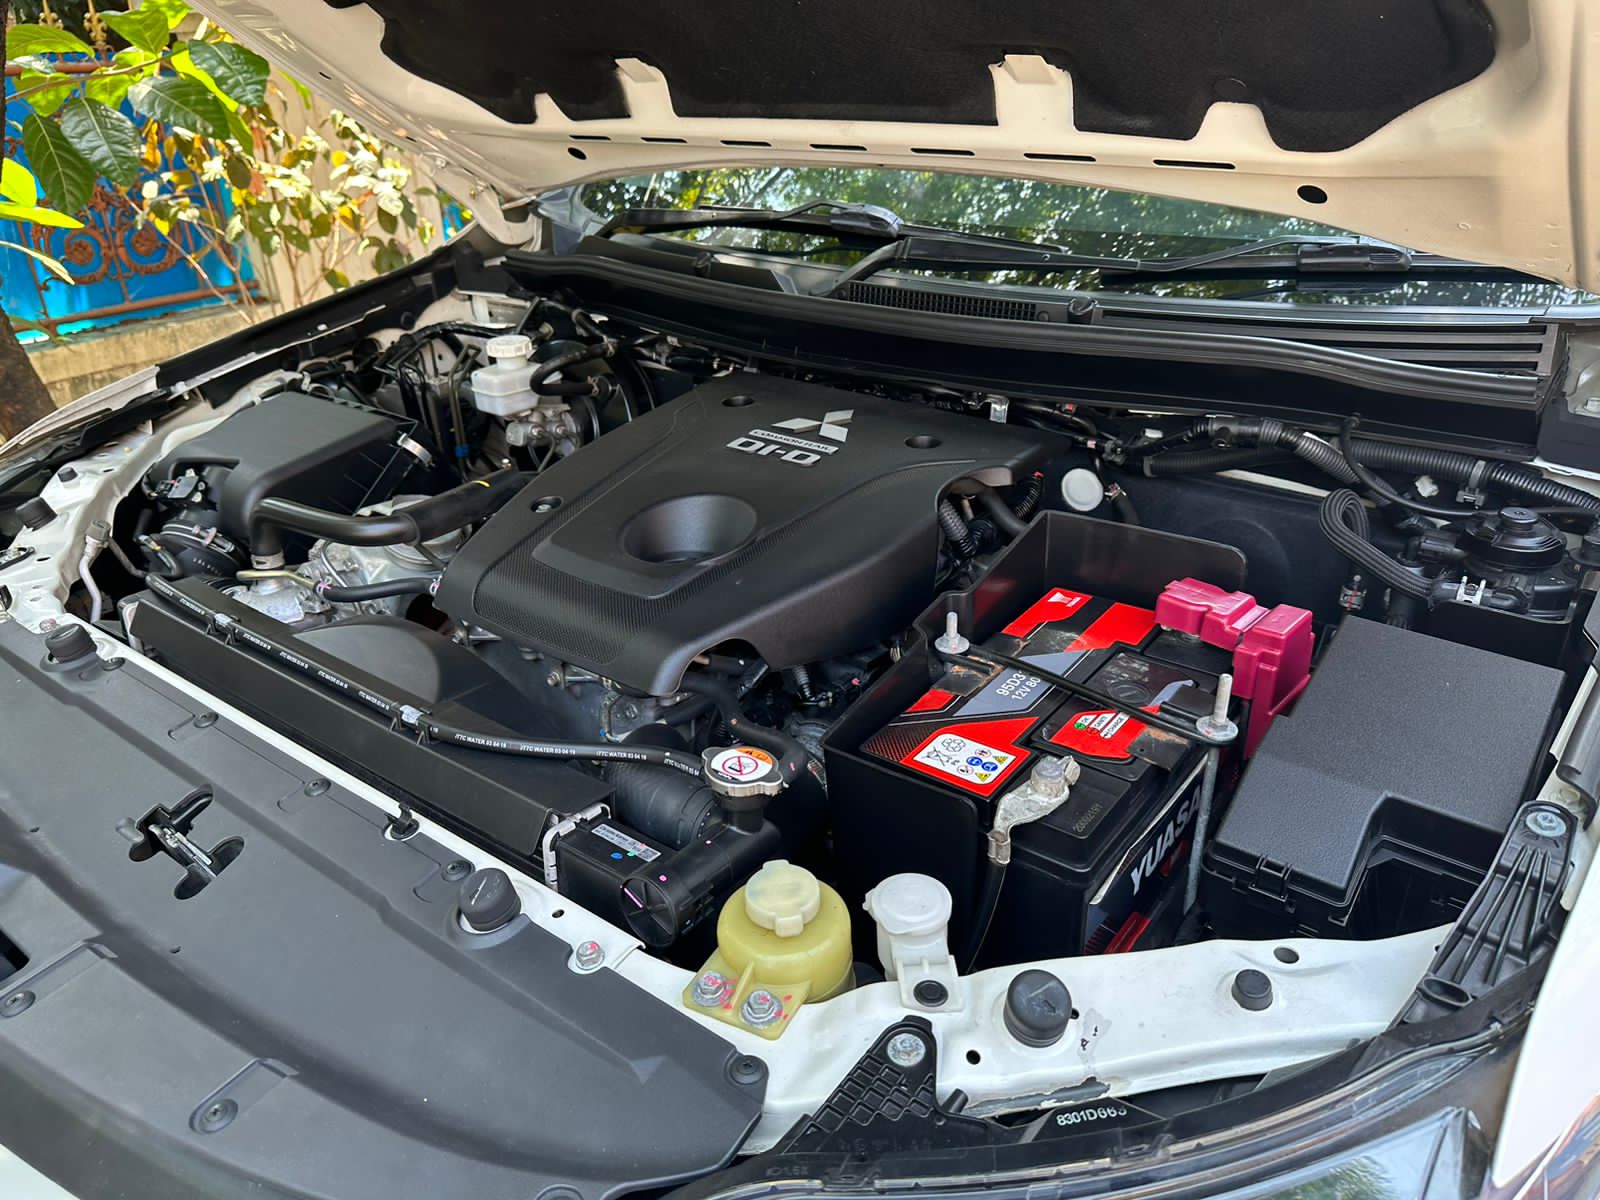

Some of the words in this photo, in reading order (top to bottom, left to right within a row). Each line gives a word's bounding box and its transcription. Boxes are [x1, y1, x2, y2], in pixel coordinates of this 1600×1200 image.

[726, 437, 821, 466] DI-D
[995, 670, 1027, 696] 95D3
[1011, 685, 1031, 700] 12V
[467, 735, 486, 745] WATER
[534, 745, 554, 754] WATER
[609, 751, 627, 759] WATER
[1130, 785, 1201, 896] YUASA
